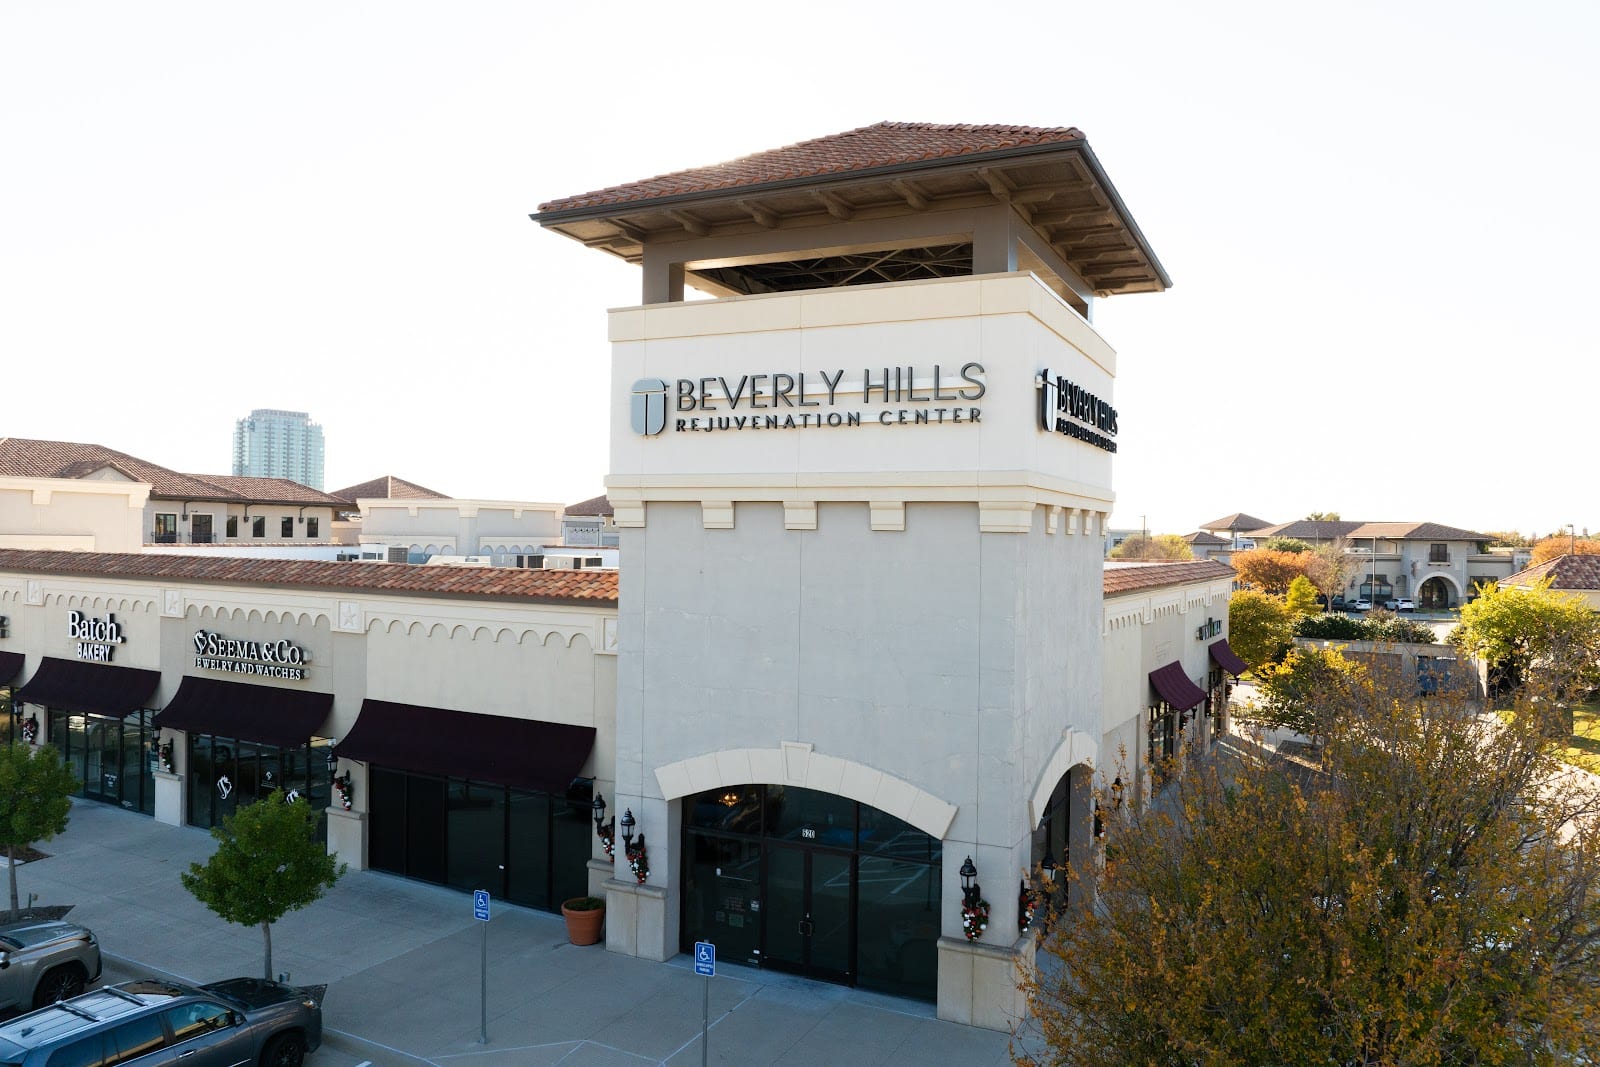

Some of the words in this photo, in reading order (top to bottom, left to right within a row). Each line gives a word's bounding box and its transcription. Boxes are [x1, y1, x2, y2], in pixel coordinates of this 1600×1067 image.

[677, 369, 844, 412] BEVERLY
[863, 362, 986, 404] HILLS
[675, 411, 861, 433] REJUVENATION
[879, 407, 982, 426] CENTER
[67, 610, 122, 643] Batch.
[77, 642, 111, 662] BAKERY
[207, 633, 259, 660] SEEMA
[234, 662, 255, 674] AND
[255, 664, 301, 680] WATCHES
